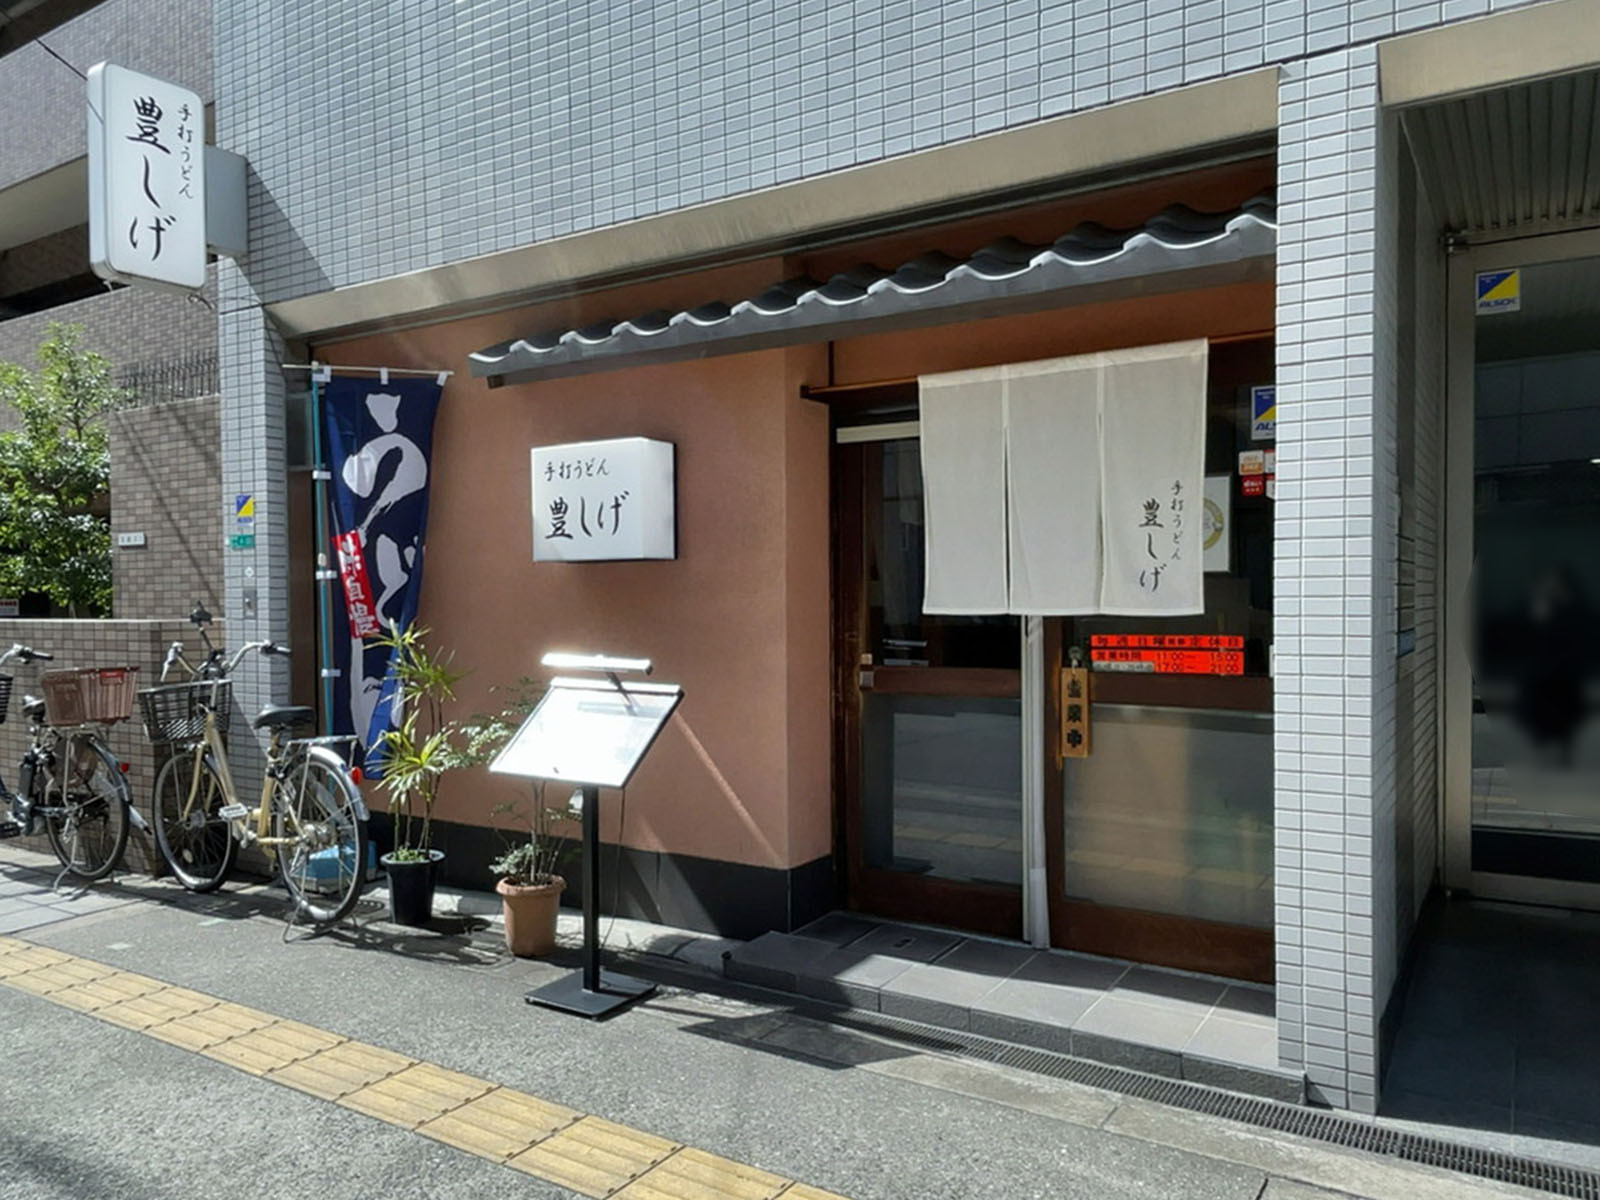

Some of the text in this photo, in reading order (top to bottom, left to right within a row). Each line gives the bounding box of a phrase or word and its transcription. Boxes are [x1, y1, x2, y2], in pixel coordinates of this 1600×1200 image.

[126, 96, 177, 261] 豊しげ
[177, 103, 194, 200] 手打うどん
[544, 457, 609, 482] 手打うどん
[545, 490, 631, 540] 豊しげ
[1138, 498, 1168, 593] 豊しげ
[1170, 480, 1184, 561] 手打うどん
